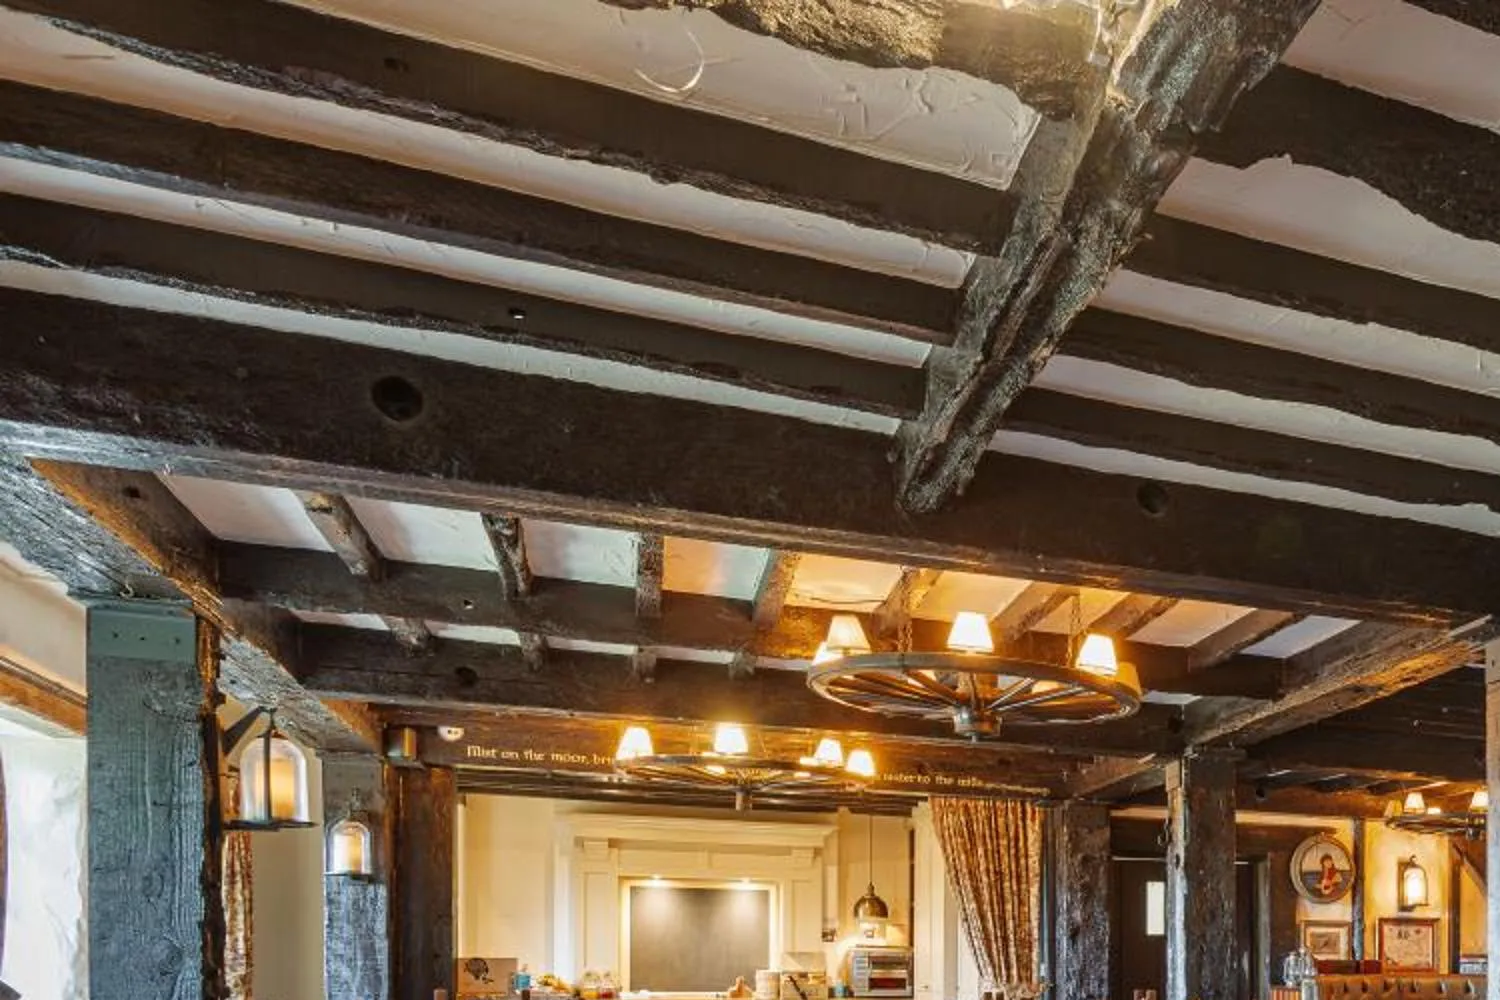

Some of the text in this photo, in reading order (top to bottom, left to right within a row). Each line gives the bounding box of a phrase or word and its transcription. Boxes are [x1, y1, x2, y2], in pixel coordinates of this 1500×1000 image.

[467, 745, 496, 759] Mist
[501, 751, 519, 760] on
[523, 748, 545, 761] the
